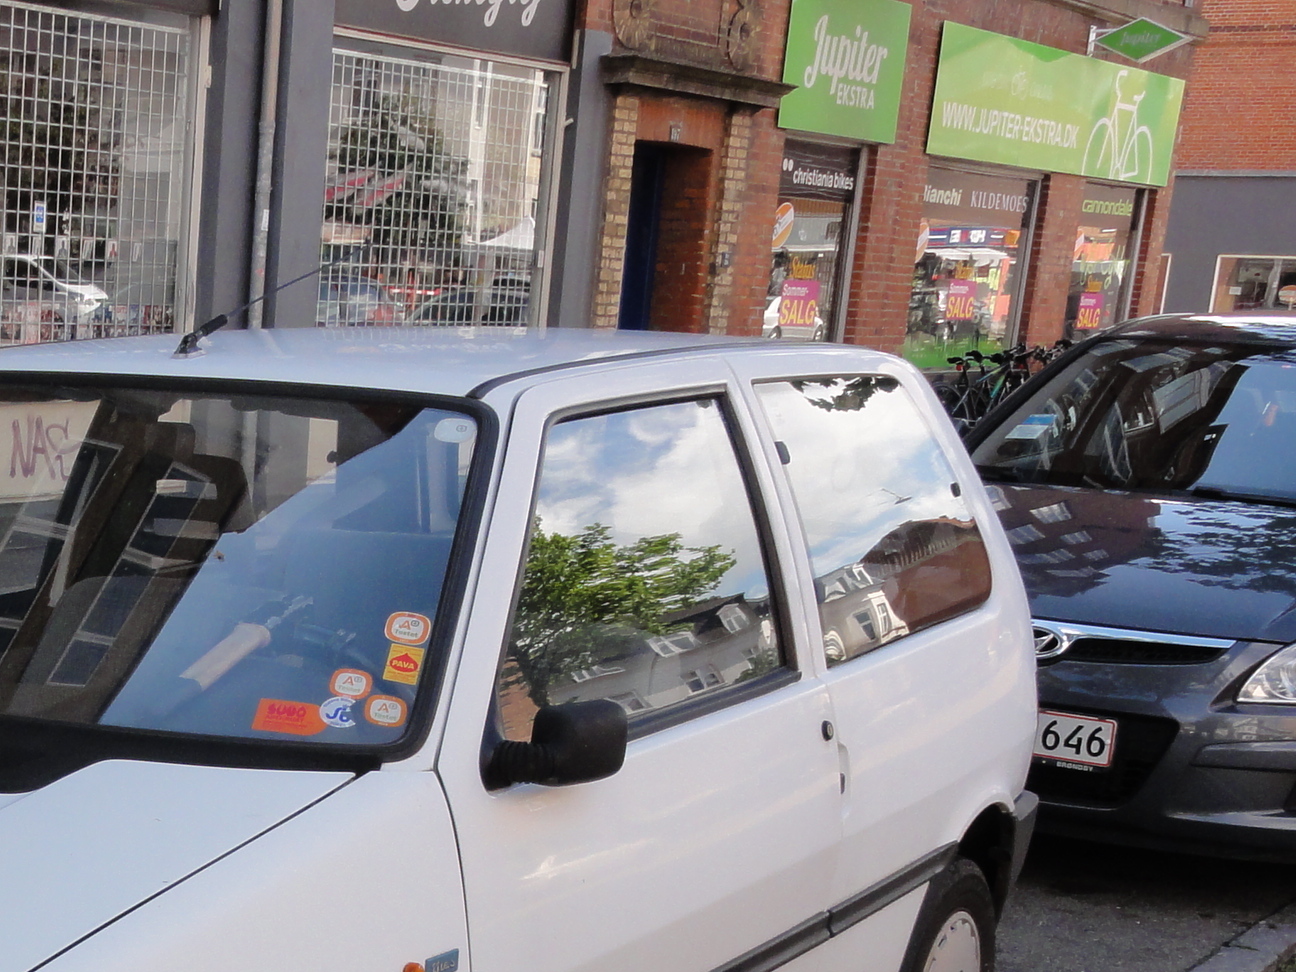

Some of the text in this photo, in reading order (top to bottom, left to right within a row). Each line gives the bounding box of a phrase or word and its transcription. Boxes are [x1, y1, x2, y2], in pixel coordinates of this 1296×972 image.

[804, 14, 888, 95] Jupiter
[836, 83, 875, 109] EKSTRA
[942, 101, 1080, 149] WWW.JUPITER-EKSTRA.DK
[793, 167, 854, 191] christiania bikes
[923, 185, 962, 206] ianchi
[970, 190, 1029, 214] KILDEMOES
[1082, 199, 1133, 217] cannondale
[780, 299, 817, 325] SALG
[946, 295, 975, 318] SALG
[1077, 307, 1101, 329] SALG
[391, 660, 415, 670] PAVA
[1041, 720, 1106, 758] 646
